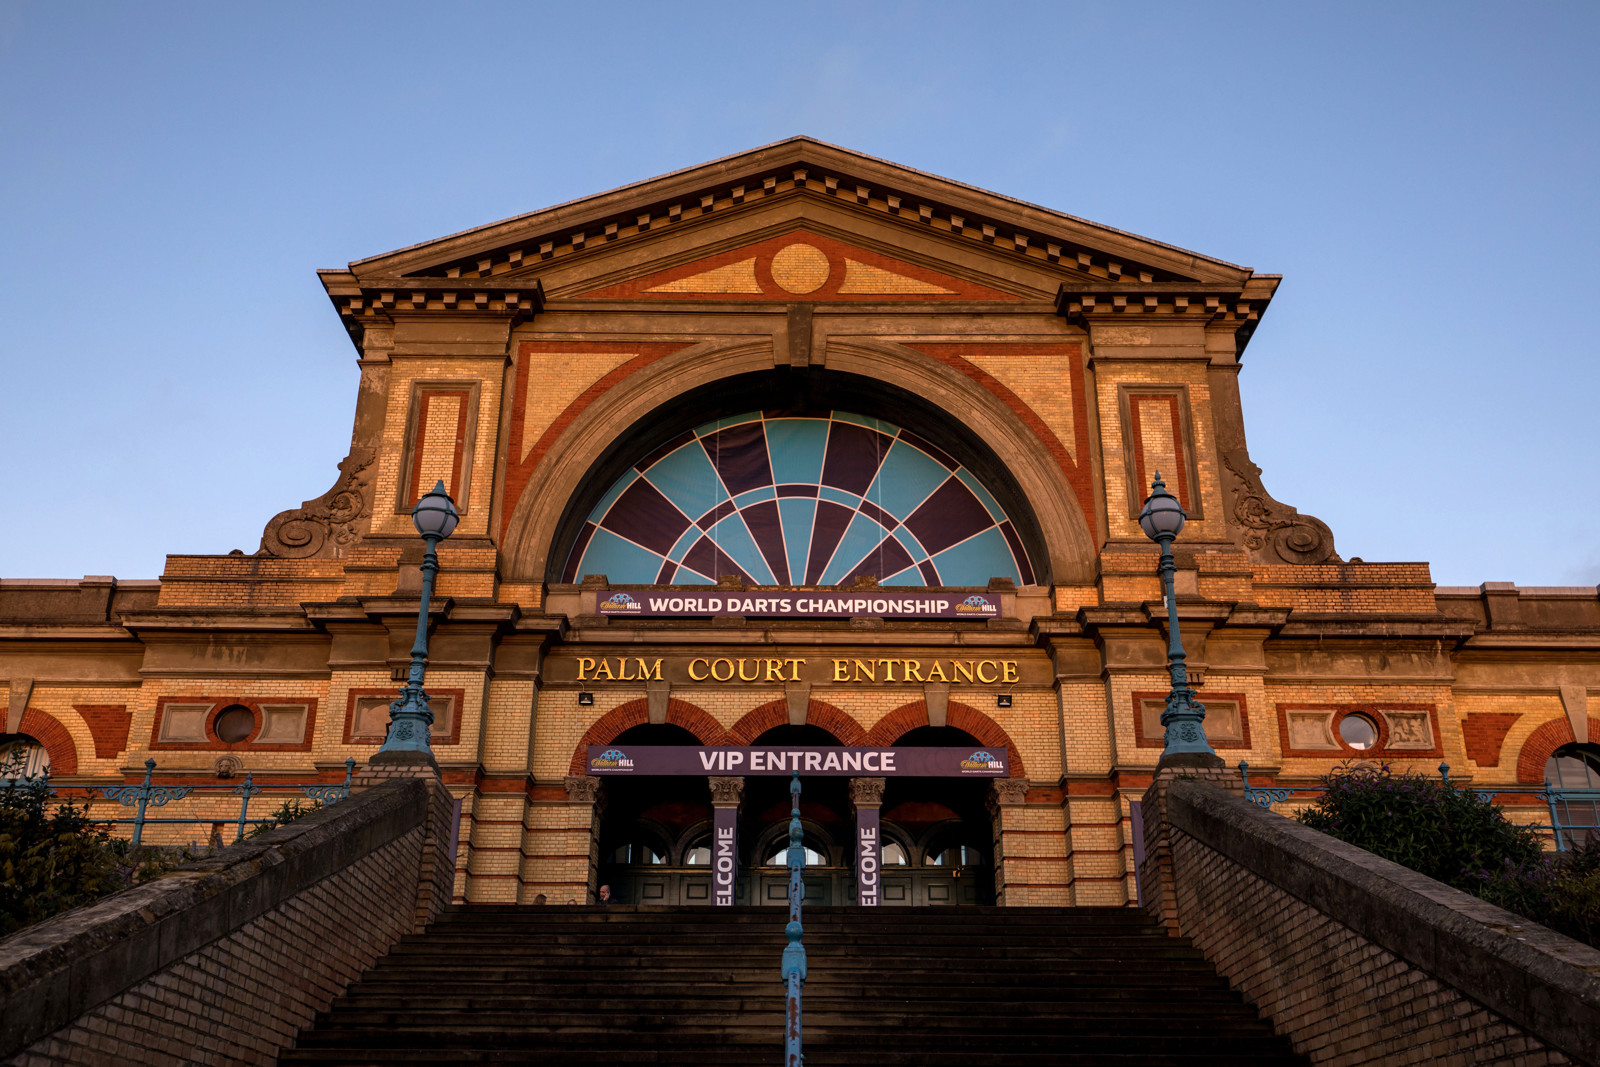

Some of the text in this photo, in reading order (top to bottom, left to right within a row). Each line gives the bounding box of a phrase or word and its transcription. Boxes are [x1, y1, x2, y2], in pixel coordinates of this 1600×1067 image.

[649, 598, 949, 614] WORLD DARTS CHAMPIONSHIP
[982, 604, 997, 612] HILL
[576, 657, 1020, 683] PALM COURT ENTRANCE
[618, 759, 634, 767] HILL
[699, 751, 897, 771] VIP ENTRANCE
